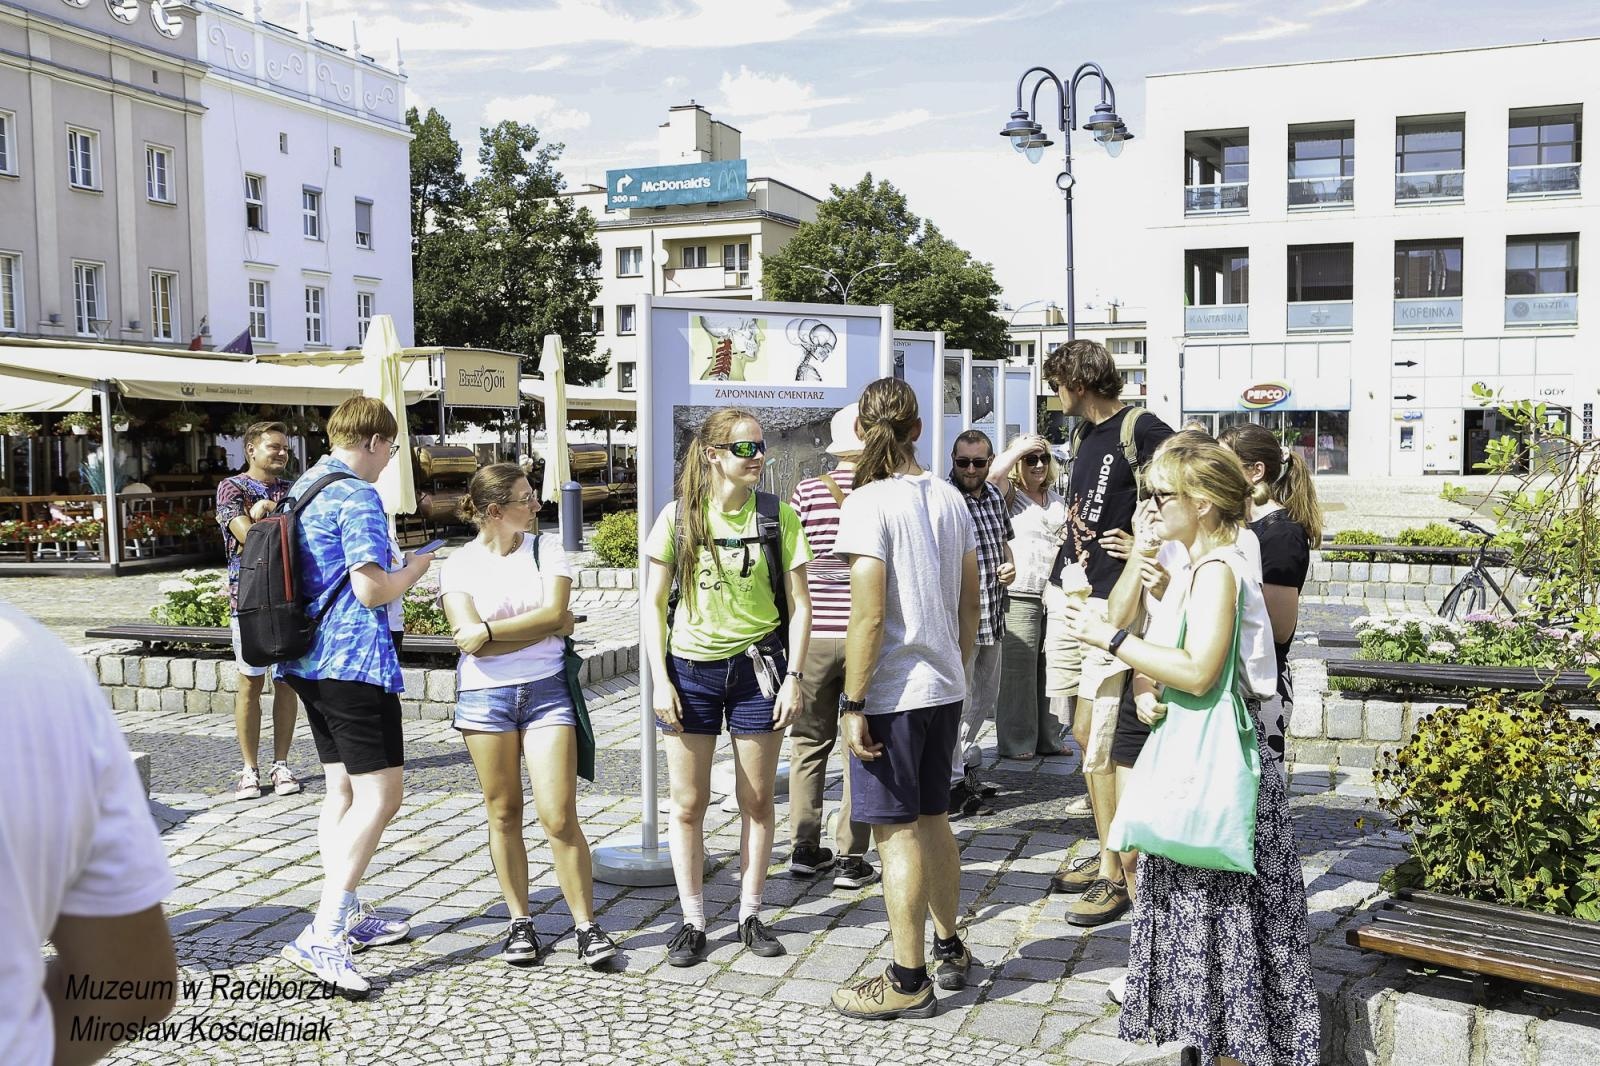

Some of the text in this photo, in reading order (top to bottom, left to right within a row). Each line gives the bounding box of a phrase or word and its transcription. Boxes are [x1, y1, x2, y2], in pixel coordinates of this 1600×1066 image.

[641, 177, 711, 192] McDonald's
[612, 195, 628, 203] 300
[1402, 306, 1454, 319] KOFEINKA
[715, 388, 825, 400] ZAPOMNIANY CMENTARZ
[1247, 389, 1283, 400] PEPCO
[1539, 388, 1566, 396] LODY
[1088, 453, 1114, 523] EL PENDO
[1087, 489, 1095, 499] DE
